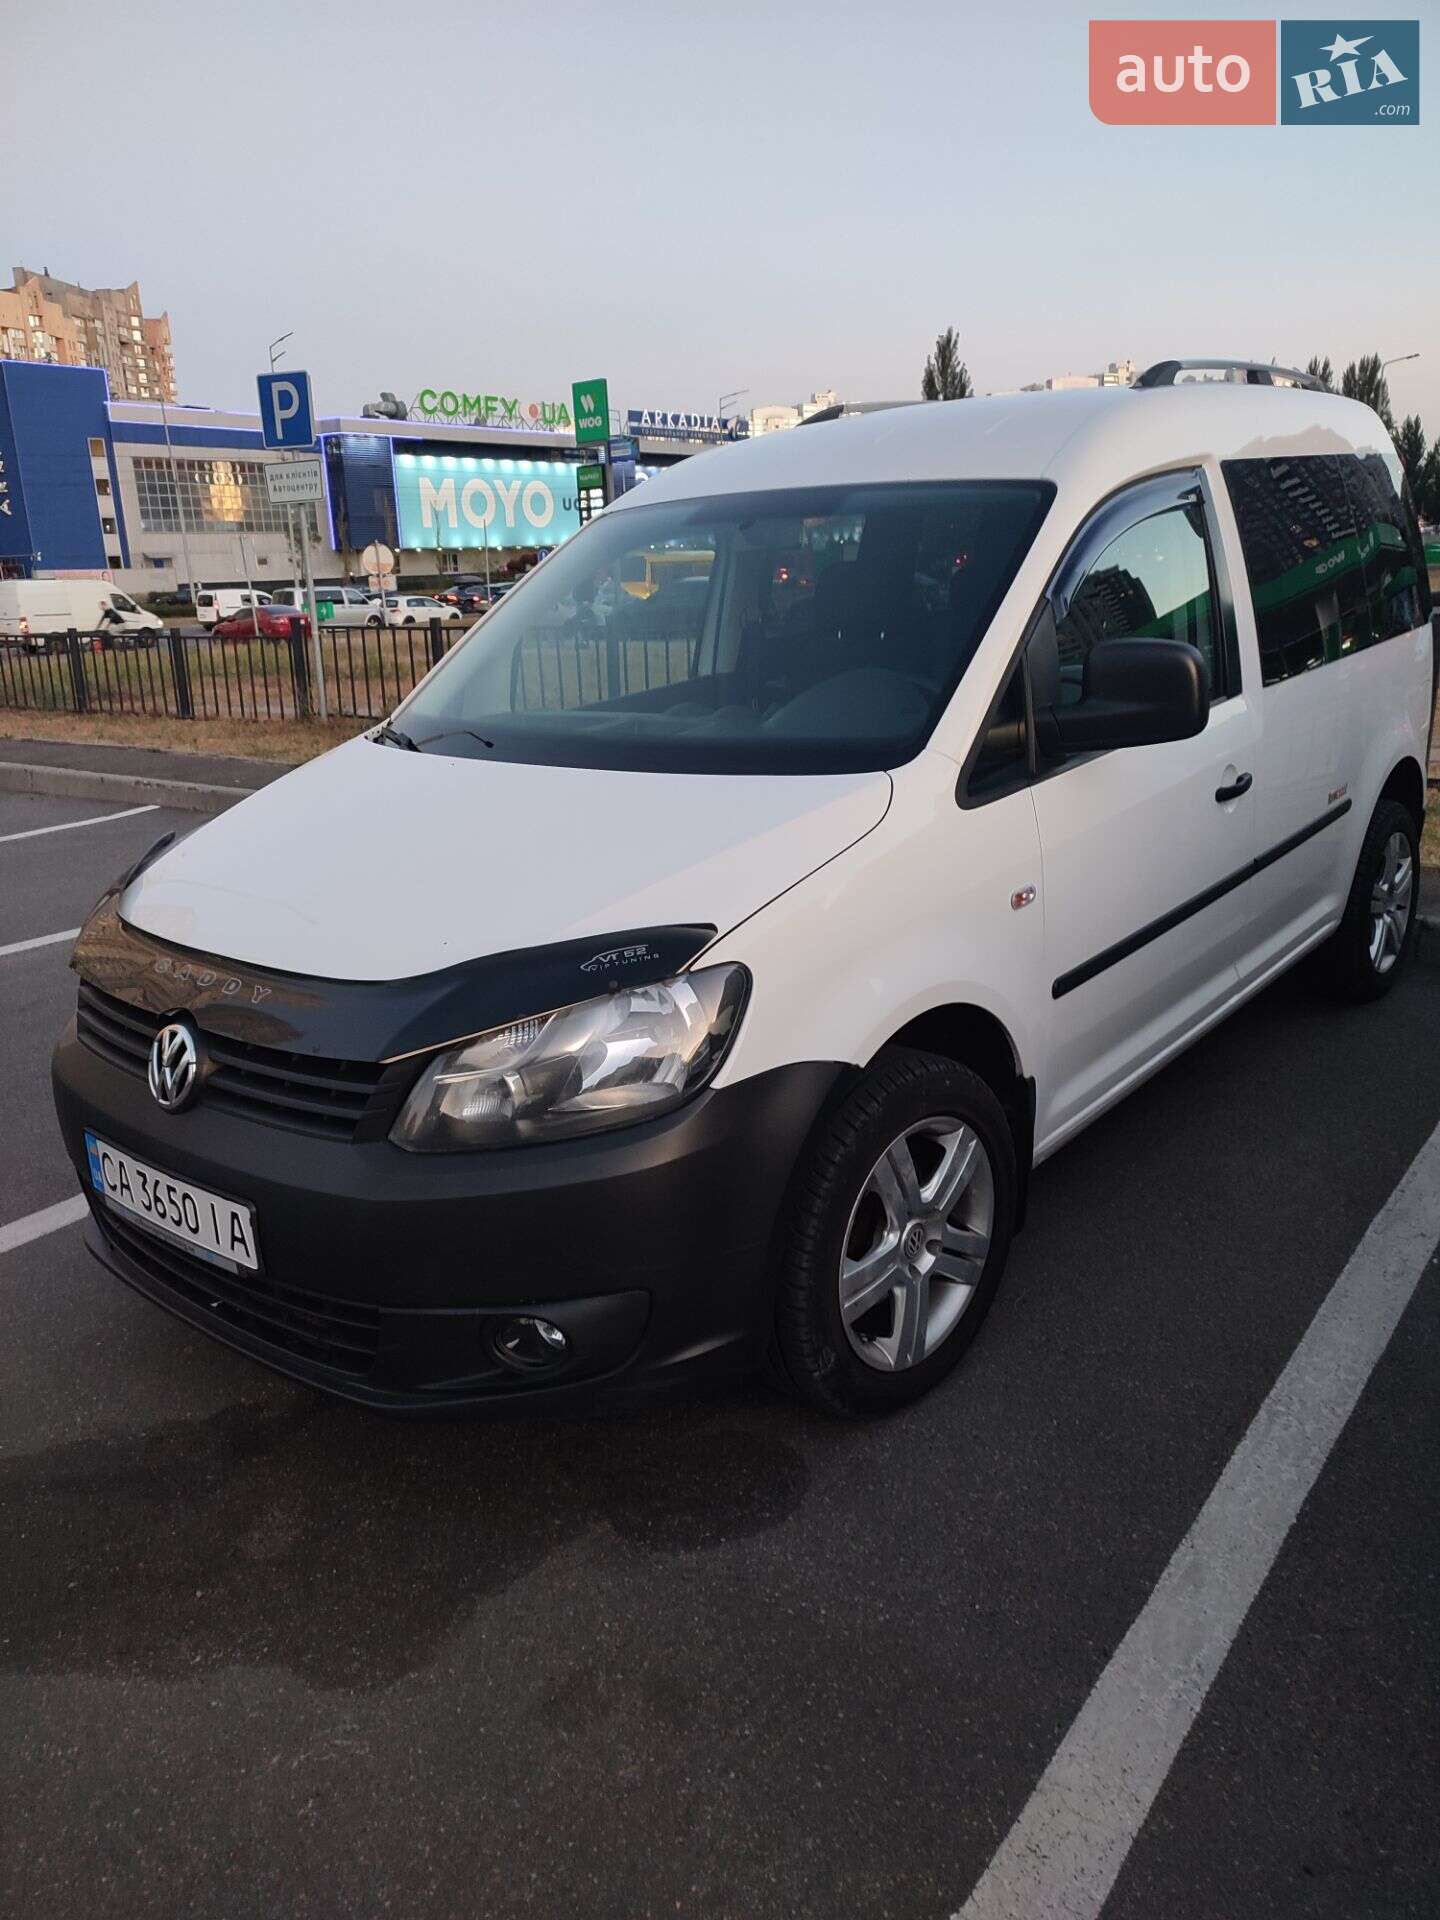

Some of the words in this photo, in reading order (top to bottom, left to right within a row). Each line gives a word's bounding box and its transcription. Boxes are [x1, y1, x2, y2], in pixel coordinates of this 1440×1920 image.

[271, 381, 300, 440] P
[420, 389, 518, 420] COMFY
[579, 416, 602, 429] WOG
[641, 408, 721, 431] ARKADIA
[419, 477, 554, 528] MOYO
[102, 1152, 134, 1202] CA
[136, 1169, 200, 1234] 3650
[210, 1202, 250, 1258] IA
